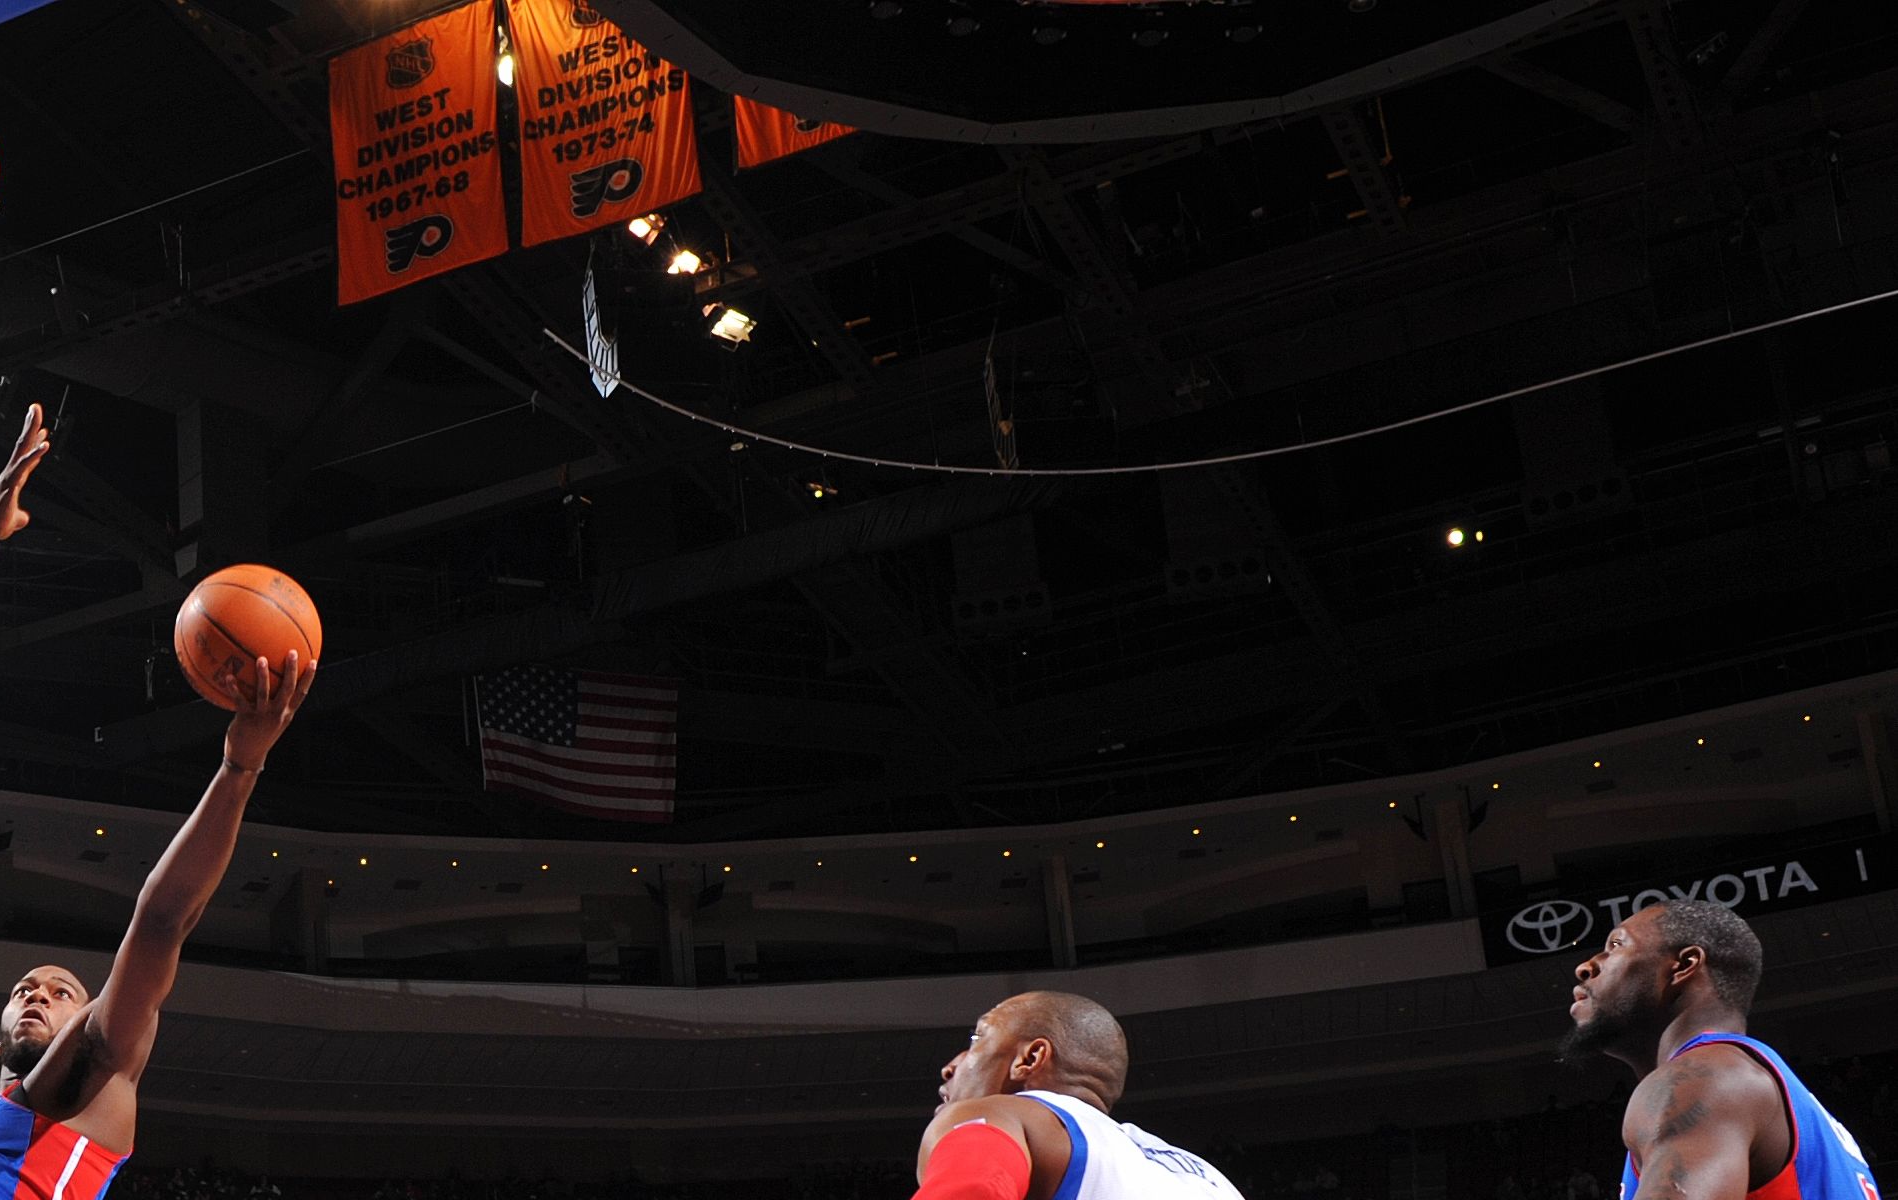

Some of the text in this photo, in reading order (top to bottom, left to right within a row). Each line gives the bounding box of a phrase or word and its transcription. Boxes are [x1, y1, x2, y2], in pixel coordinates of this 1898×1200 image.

[524, 69, 685, 141] CHAMPIONS
[539, 54, 662, 108] DIVISION
[375, 88, 452, 132] WEST
[338, 131, 497, 200] CHAMPIONS
[357, 110, 475, 168] DIVISION
[552, 116, 655, 164] 1973-74
[364, 171, 470, 222] 1967-68
